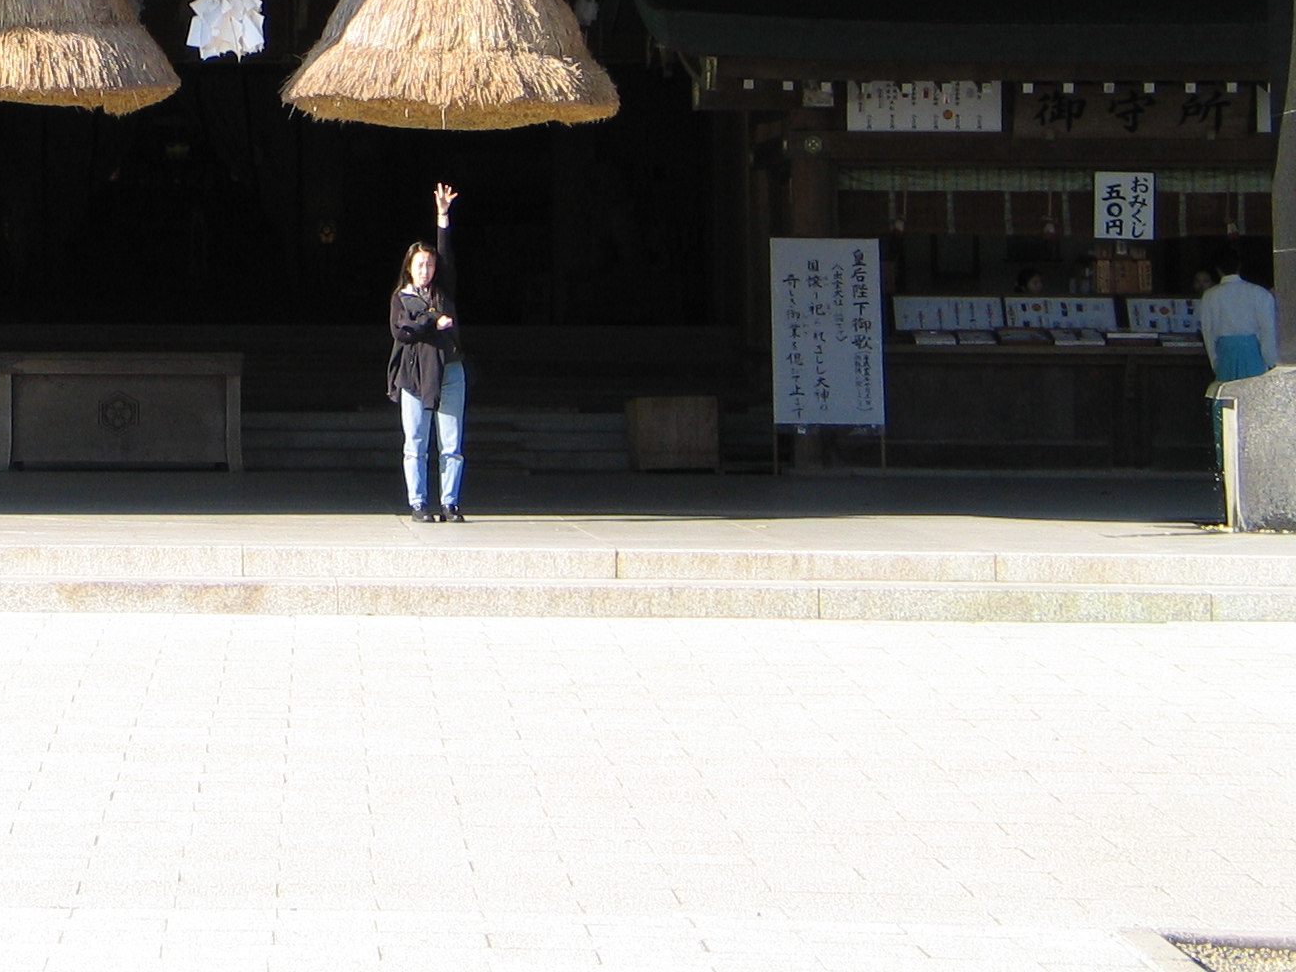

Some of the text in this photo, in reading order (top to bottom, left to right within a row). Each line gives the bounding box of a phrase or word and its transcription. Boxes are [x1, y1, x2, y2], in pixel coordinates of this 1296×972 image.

[1033, 89, 1231, 131] 御守所
[1129, 176, 1149, 238] おみくじ
